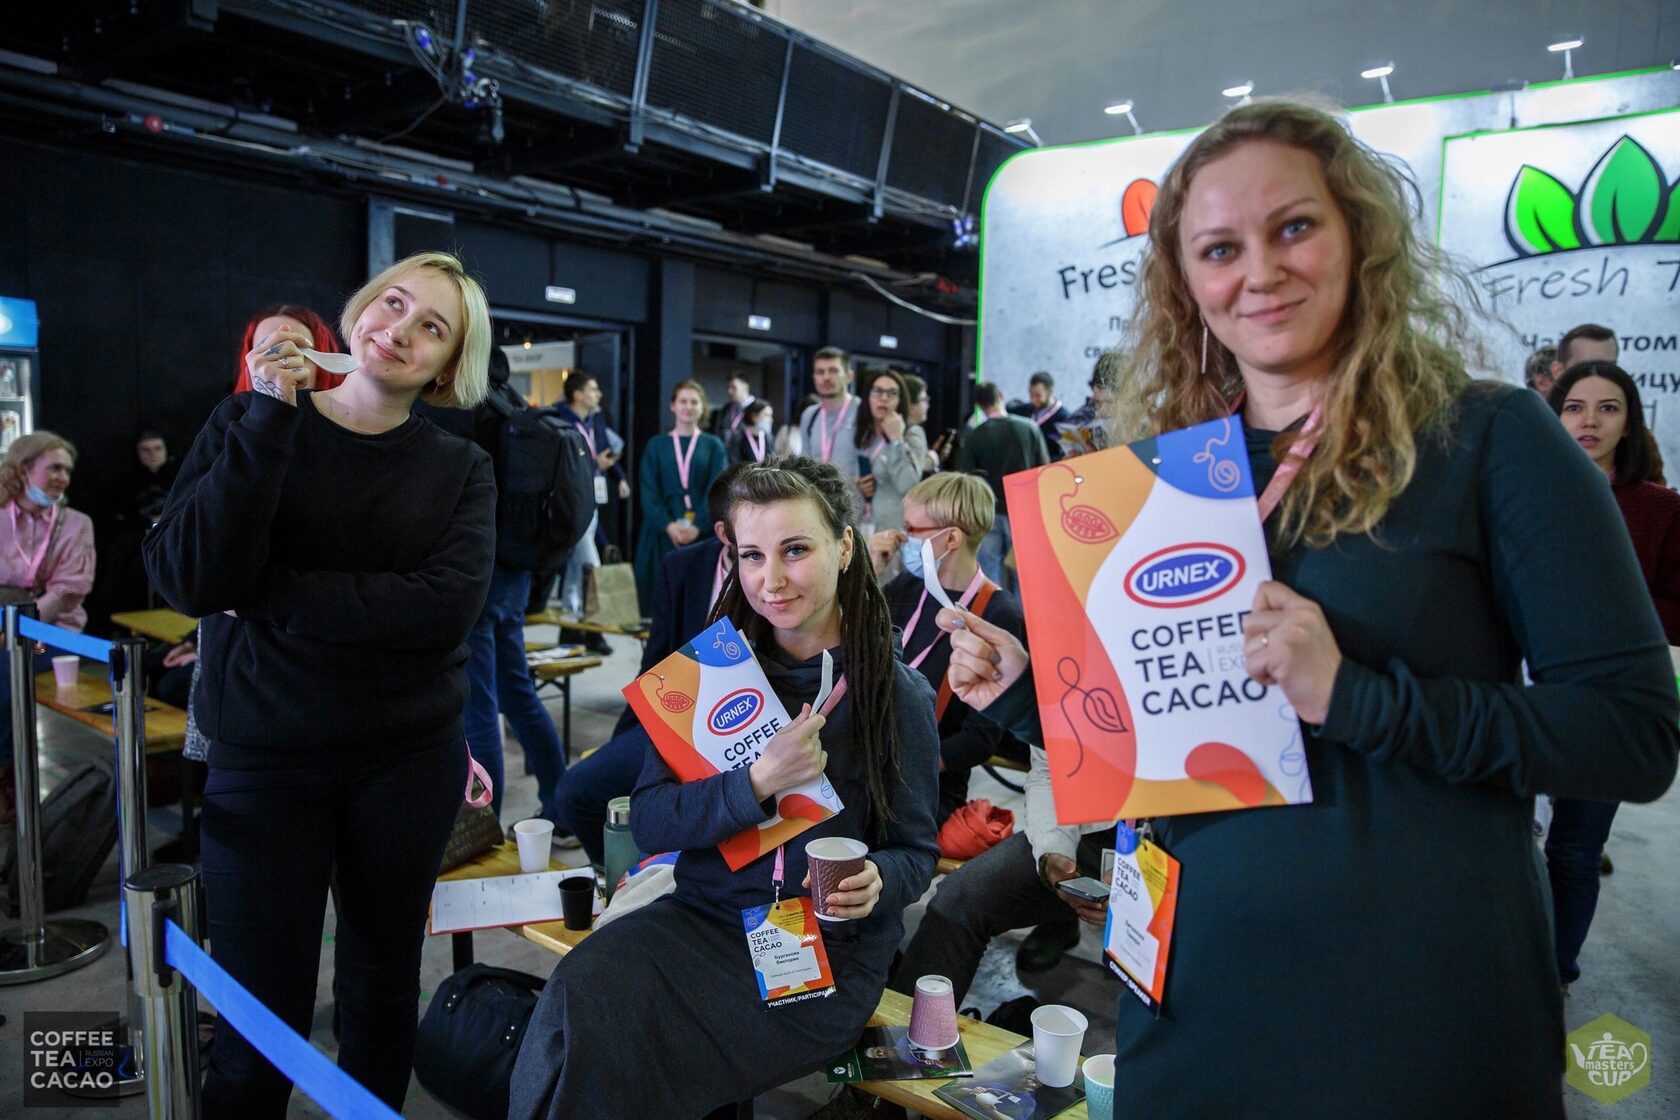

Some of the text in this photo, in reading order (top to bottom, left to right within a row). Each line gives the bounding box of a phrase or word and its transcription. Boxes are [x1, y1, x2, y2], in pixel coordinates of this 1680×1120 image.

[1058, 260, 1137, 299] Fres
[1482, 257, 1628, 313] Fresh
[1620, 336, 1677, 351] том
[1142, 558, 1220, 592] URNEX
[1135, 651, 1205, 683] TEA
[1142, 677, 1268, 716] CACAO
[716, 697, 753, 727] URNEX
[724, 717, 782, 761] COFFEE
[1117, 857, 1141, 881] COFFEE
[1117, 867, 1129, 882] TEA
[1115, 877, 1138, 902] CACAO
[750, 927, 779, 939] COFFEE
[752, 937, 769, 946] TEA
[754, 941, 783, 953] CACAO
